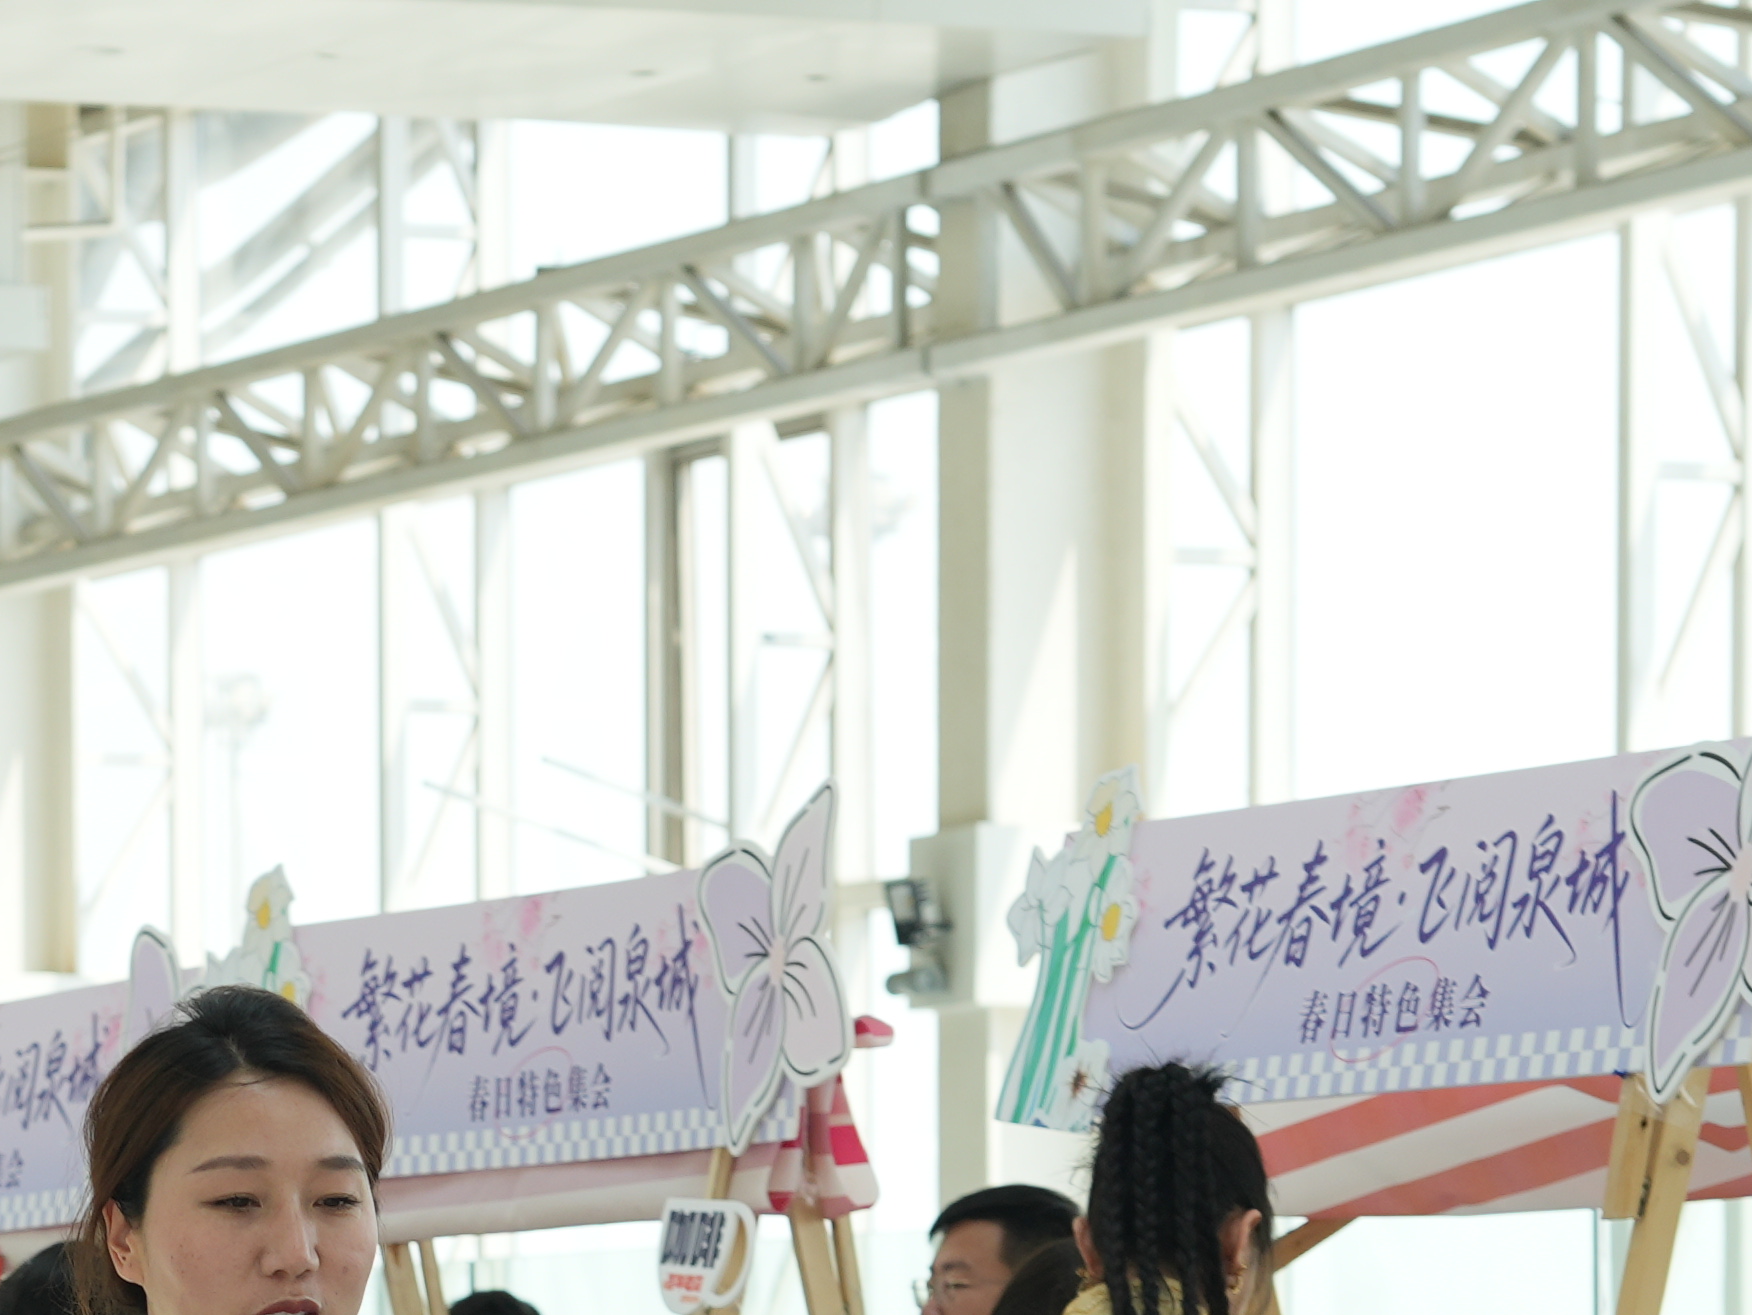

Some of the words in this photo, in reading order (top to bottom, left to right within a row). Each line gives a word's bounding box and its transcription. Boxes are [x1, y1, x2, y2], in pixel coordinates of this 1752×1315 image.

[1300, 972, 1491, 1042] 春日特色集会
[468, 1062, 612, 1123] 春日特色集会
